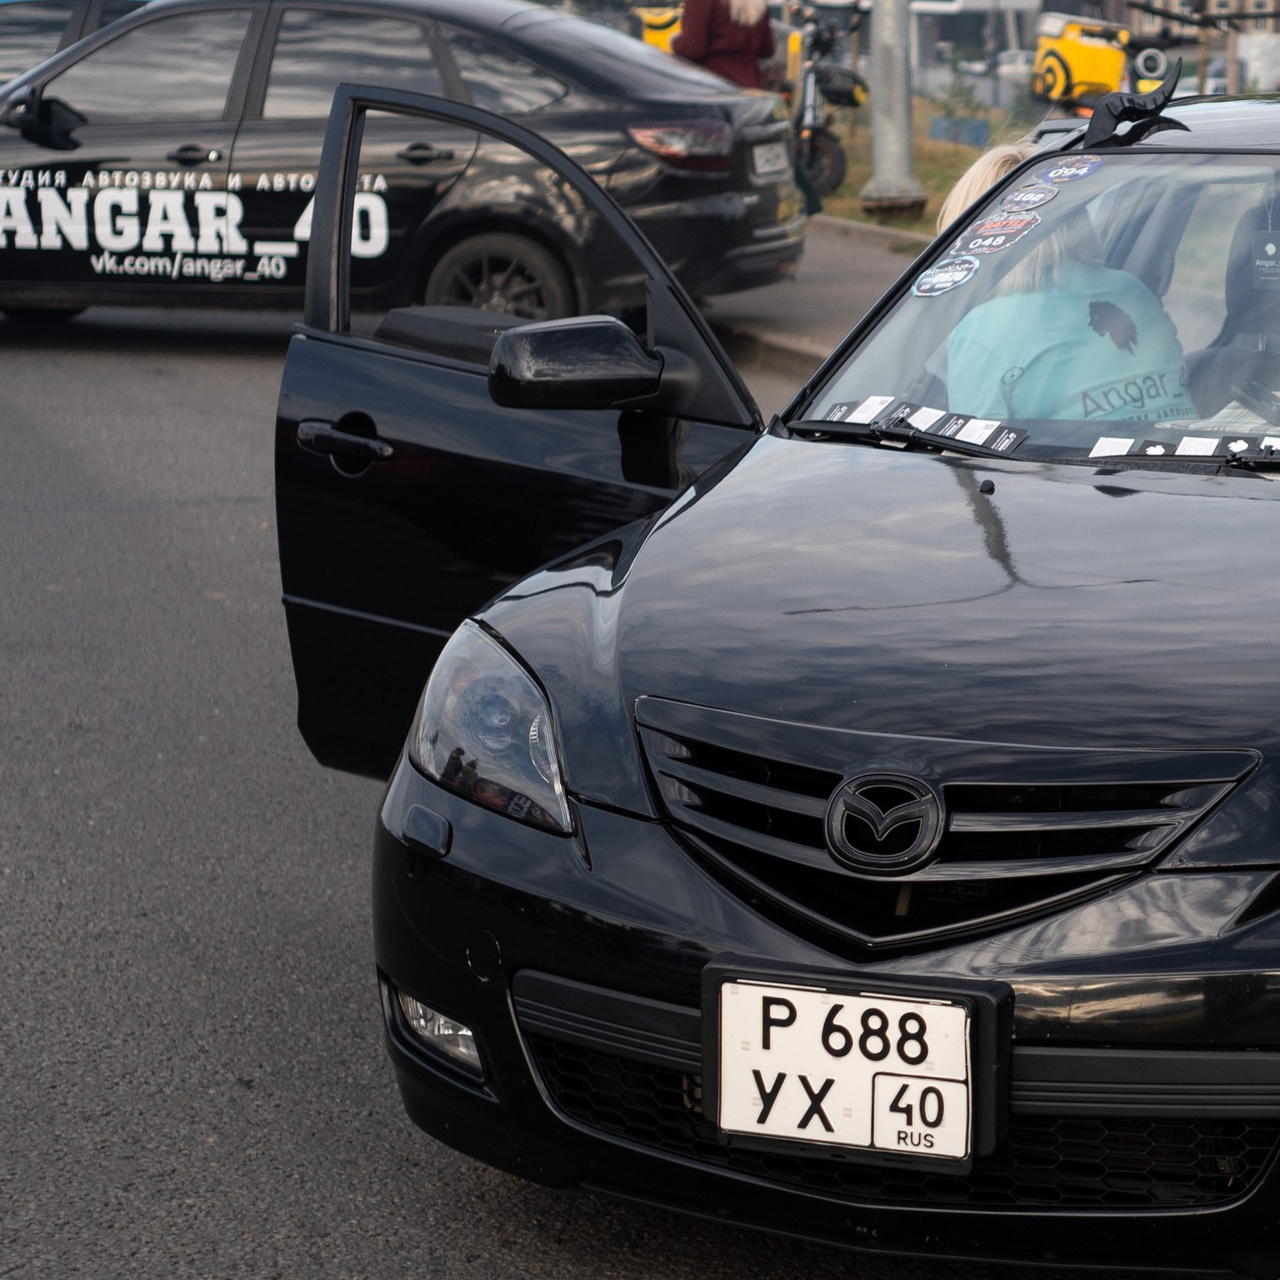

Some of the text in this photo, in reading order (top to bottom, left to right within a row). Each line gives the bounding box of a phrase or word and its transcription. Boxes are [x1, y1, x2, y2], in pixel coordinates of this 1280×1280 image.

[82, 170, 214, 190] АВТОЗВУКА
[227, 173, 242, 191] И
[256, 173, 389, 192] АВТОТА
[969, 236, 1006, 249] 048
[90, 250, 288, 282] vk.com/angar_40
[761, 995, 930, 1066] Р 688
[752, 1068, 836, 1133] УХ
[888, 1083, 945, 1129] 40
[896, 1129, 935, 1149] RUS
